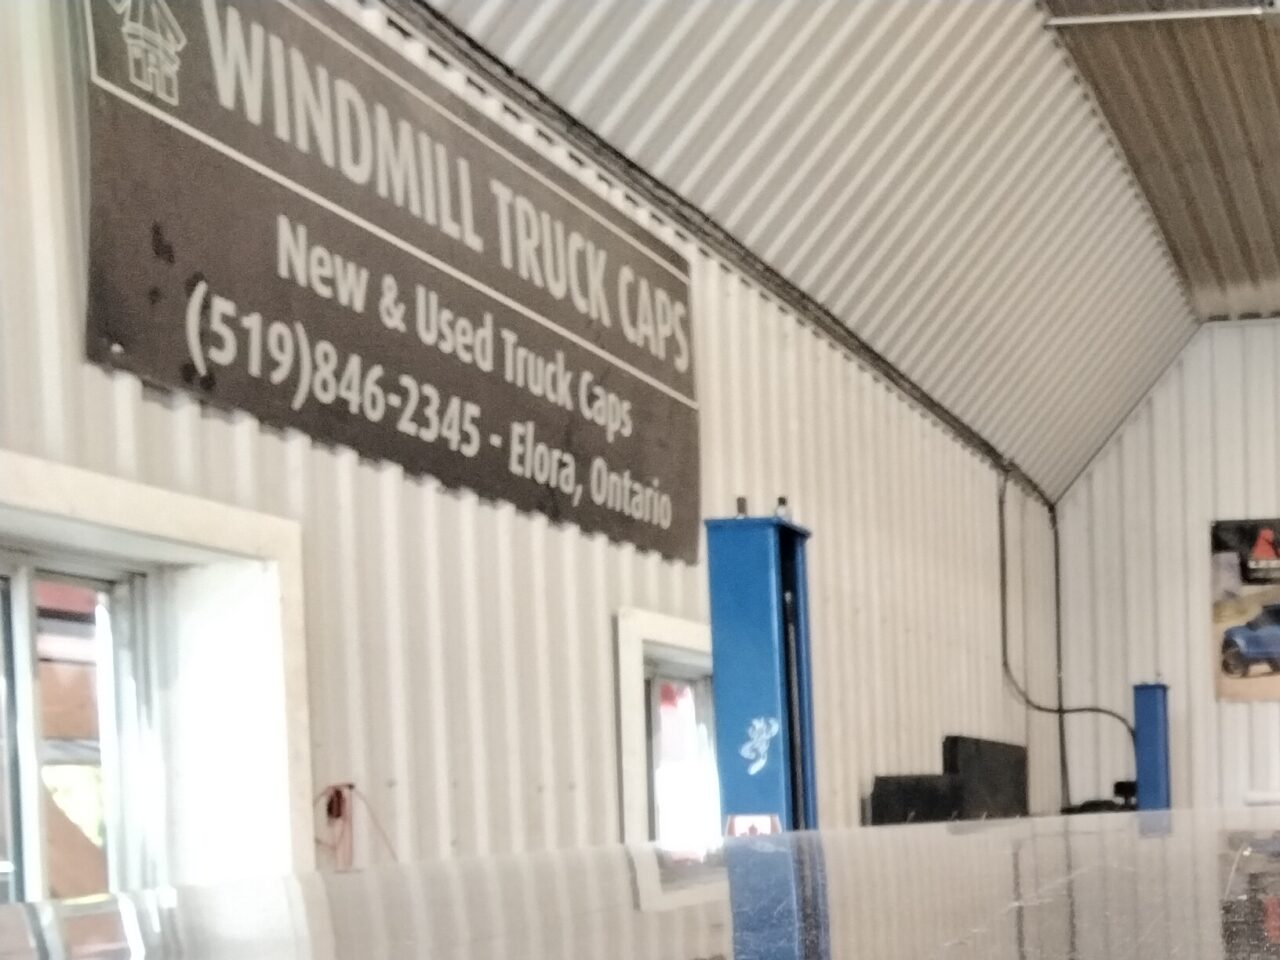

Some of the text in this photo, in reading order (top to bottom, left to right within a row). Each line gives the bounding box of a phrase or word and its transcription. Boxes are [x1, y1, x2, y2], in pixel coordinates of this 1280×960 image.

[201, 0, 691, 375] WINDMILL TRUCK CAPS
[185, 280, 481, 458] (519)846-2345
[509, 421, 584, 505] Elora,
[590, 456, 673, 531] Ontario
[278, 214, 633, 442] New & Used Truck Caps
